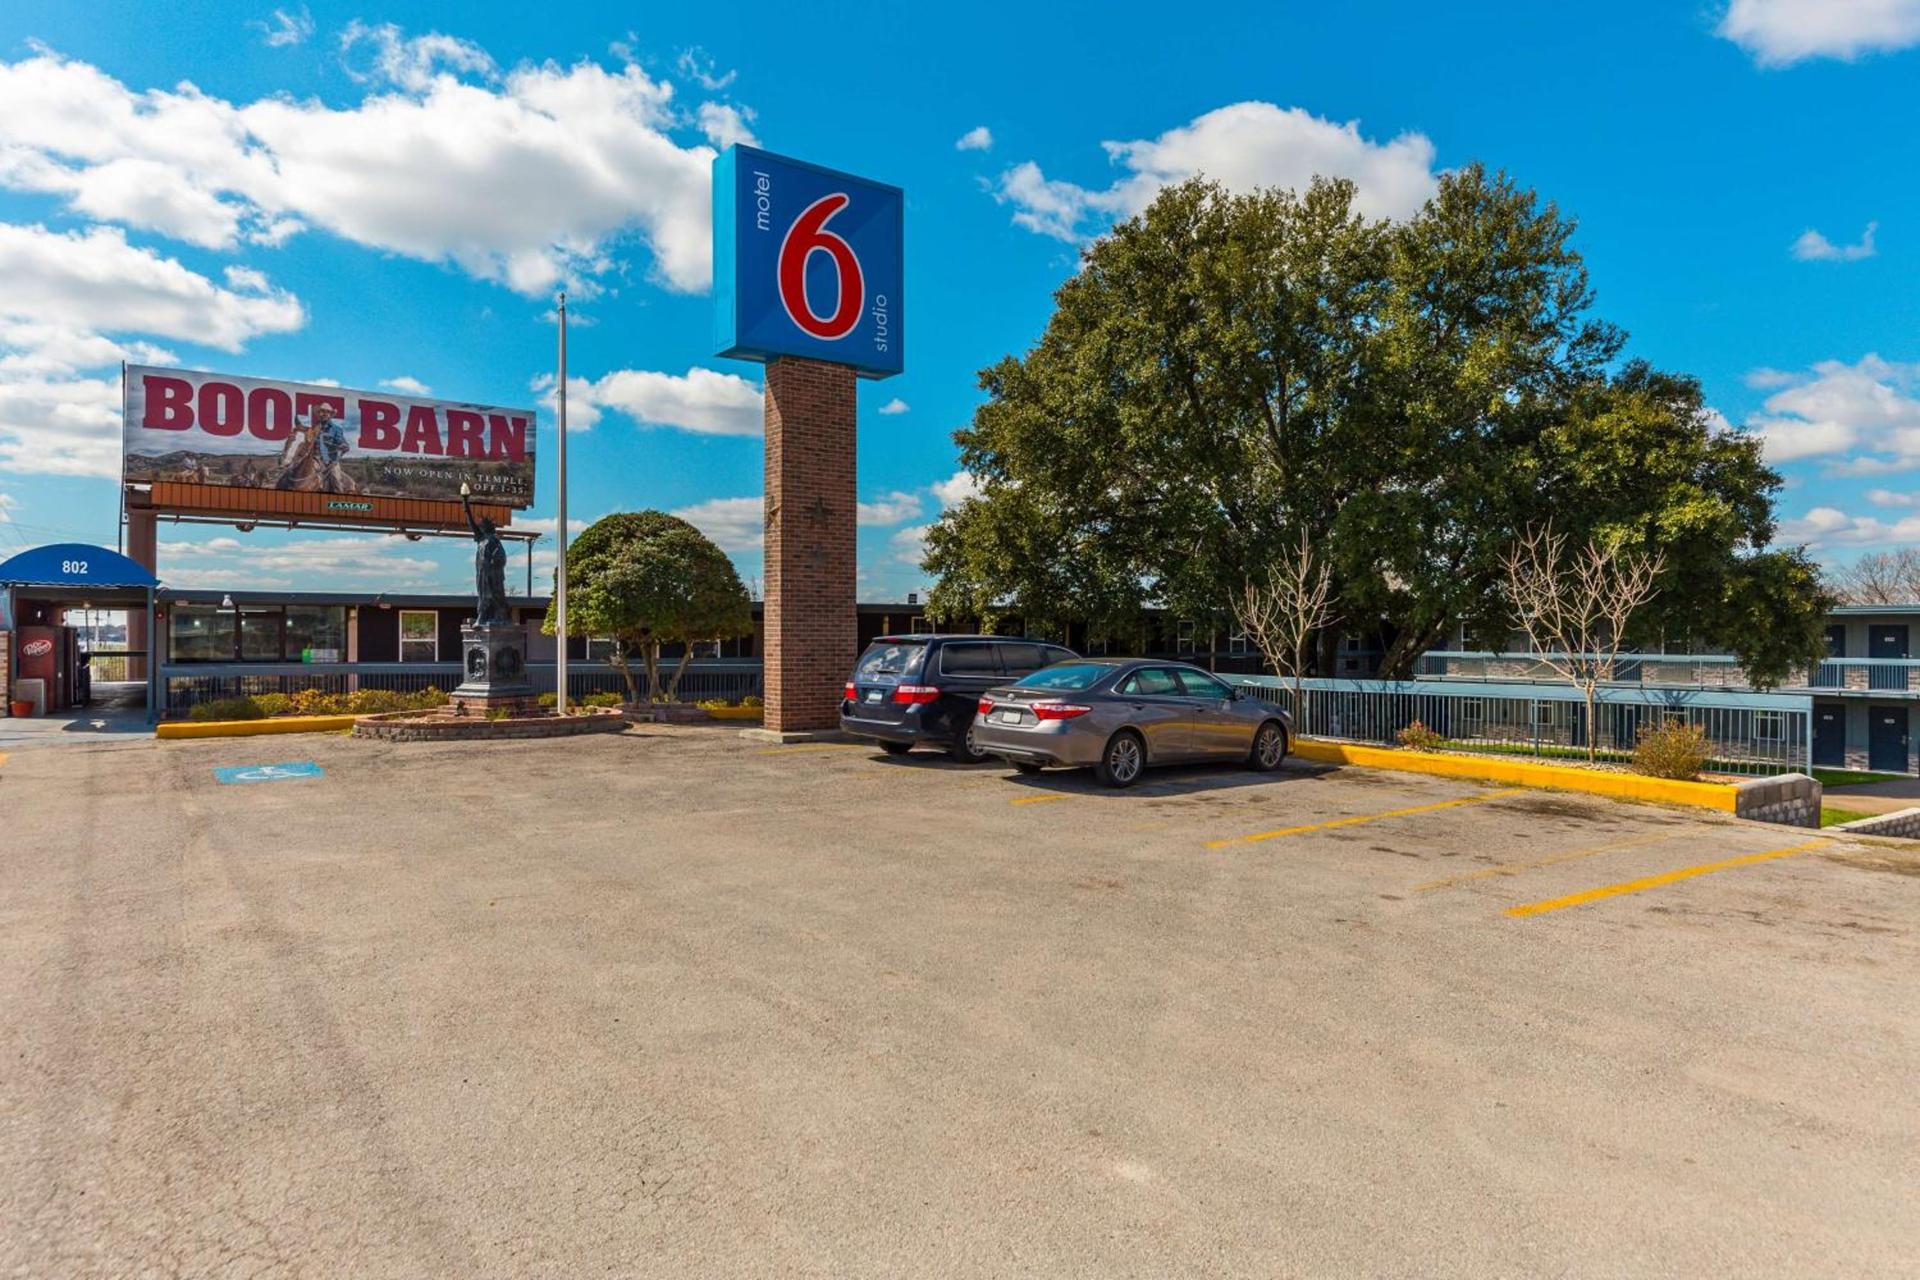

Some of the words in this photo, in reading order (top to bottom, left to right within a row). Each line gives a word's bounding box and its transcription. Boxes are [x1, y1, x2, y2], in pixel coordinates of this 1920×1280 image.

[754, 171, 770, 230] motel
[777, 192, 865, 341] 6
[873, 295, 888, 352] studio
[358, 399, 527, 462] BARN
[384, 466, 413, 476] NOW
[420, 469, 453, 480] OPEN
[459, 473, 471, 481] IN
[474, 484, 496, 492] OFF
[63, 561, 88, 574] 802
